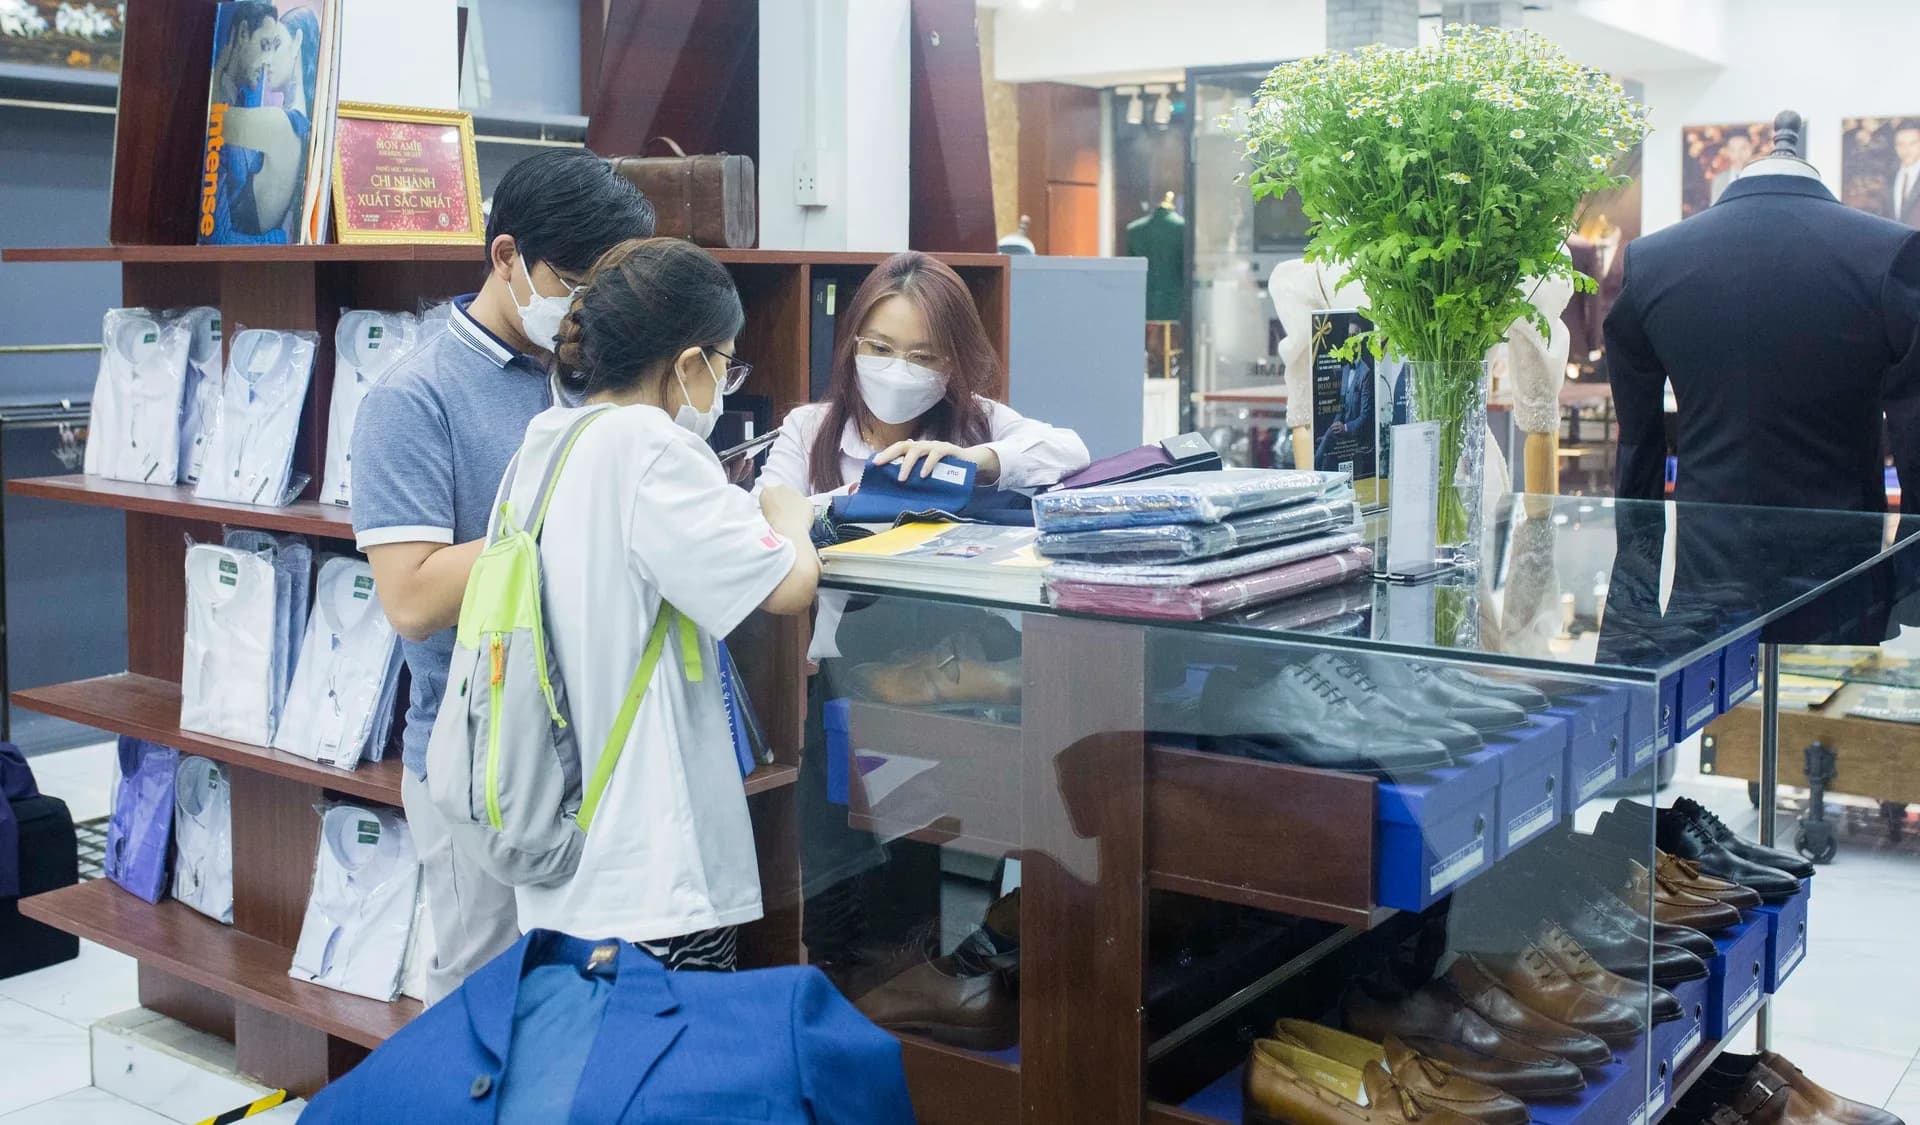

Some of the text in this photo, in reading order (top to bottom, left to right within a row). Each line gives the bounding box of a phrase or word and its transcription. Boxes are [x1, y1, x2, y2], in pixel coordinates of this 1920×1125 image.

[376, 140, 398, 150] MON
[200, 103, 229, 236] intense
[370, 174, 391, 188] CHI
